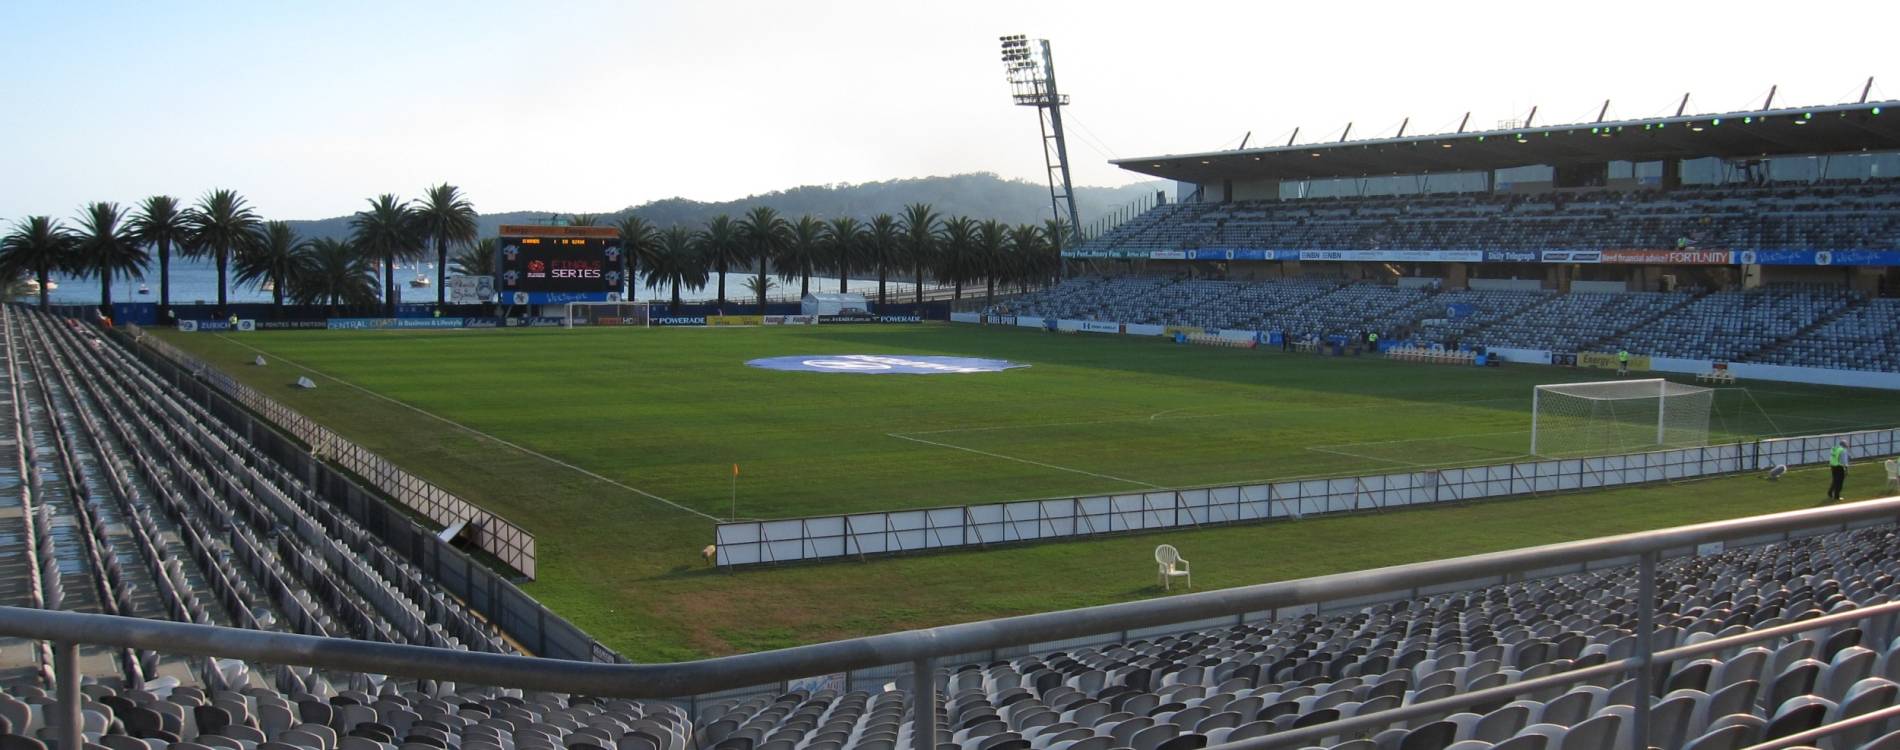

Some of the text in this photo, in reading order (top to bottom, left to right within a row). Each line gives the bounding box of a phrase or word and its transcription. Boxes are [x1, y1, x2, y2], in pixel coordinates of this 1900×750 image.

[1327, 252, 1342, 260] NBN
[1505, 251, 1536, 262] Telegraph
[1669, 252, 1727, 263] FORTUNITY
[552, 269, 601, 278] SERIES
[658, 317, 705, 325] POWERADE
[881, 315, 921, 323] POWERADE
[327, 320, 367, 330] CENTRAL
[369, 319, 397, 329] COAST
[404, 319, 430, 327] Business
